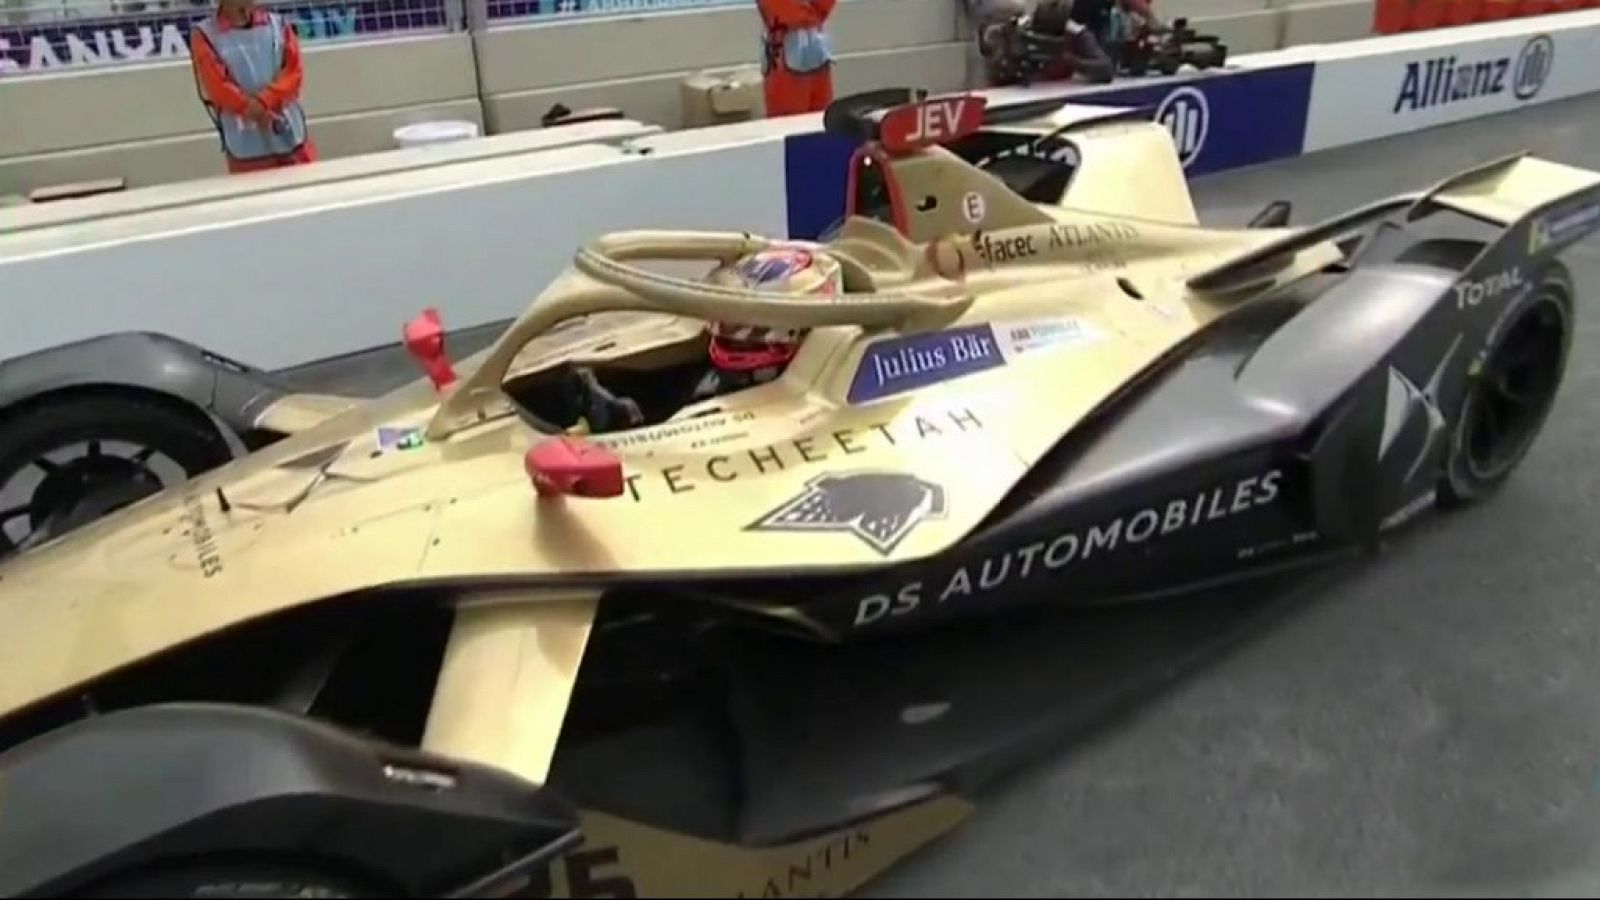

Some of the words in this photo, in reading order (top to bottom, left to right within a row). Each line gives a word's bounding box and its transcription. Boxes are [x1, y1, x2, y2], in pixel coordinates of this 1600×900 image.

[1393, 56, 1510, 114] Allianz
[905, 100, 964, 141] JEV
[1455, 265, 1523, 310] TOTAL
[873, 346, 946, 387] Julius
[950, 333, 993, 364] Bär
[623, 406, 984, 504] TECHEETAH
[853, 581, 922, 626] DS
[939, 469, 1283, 602] AUTOMOBILES
